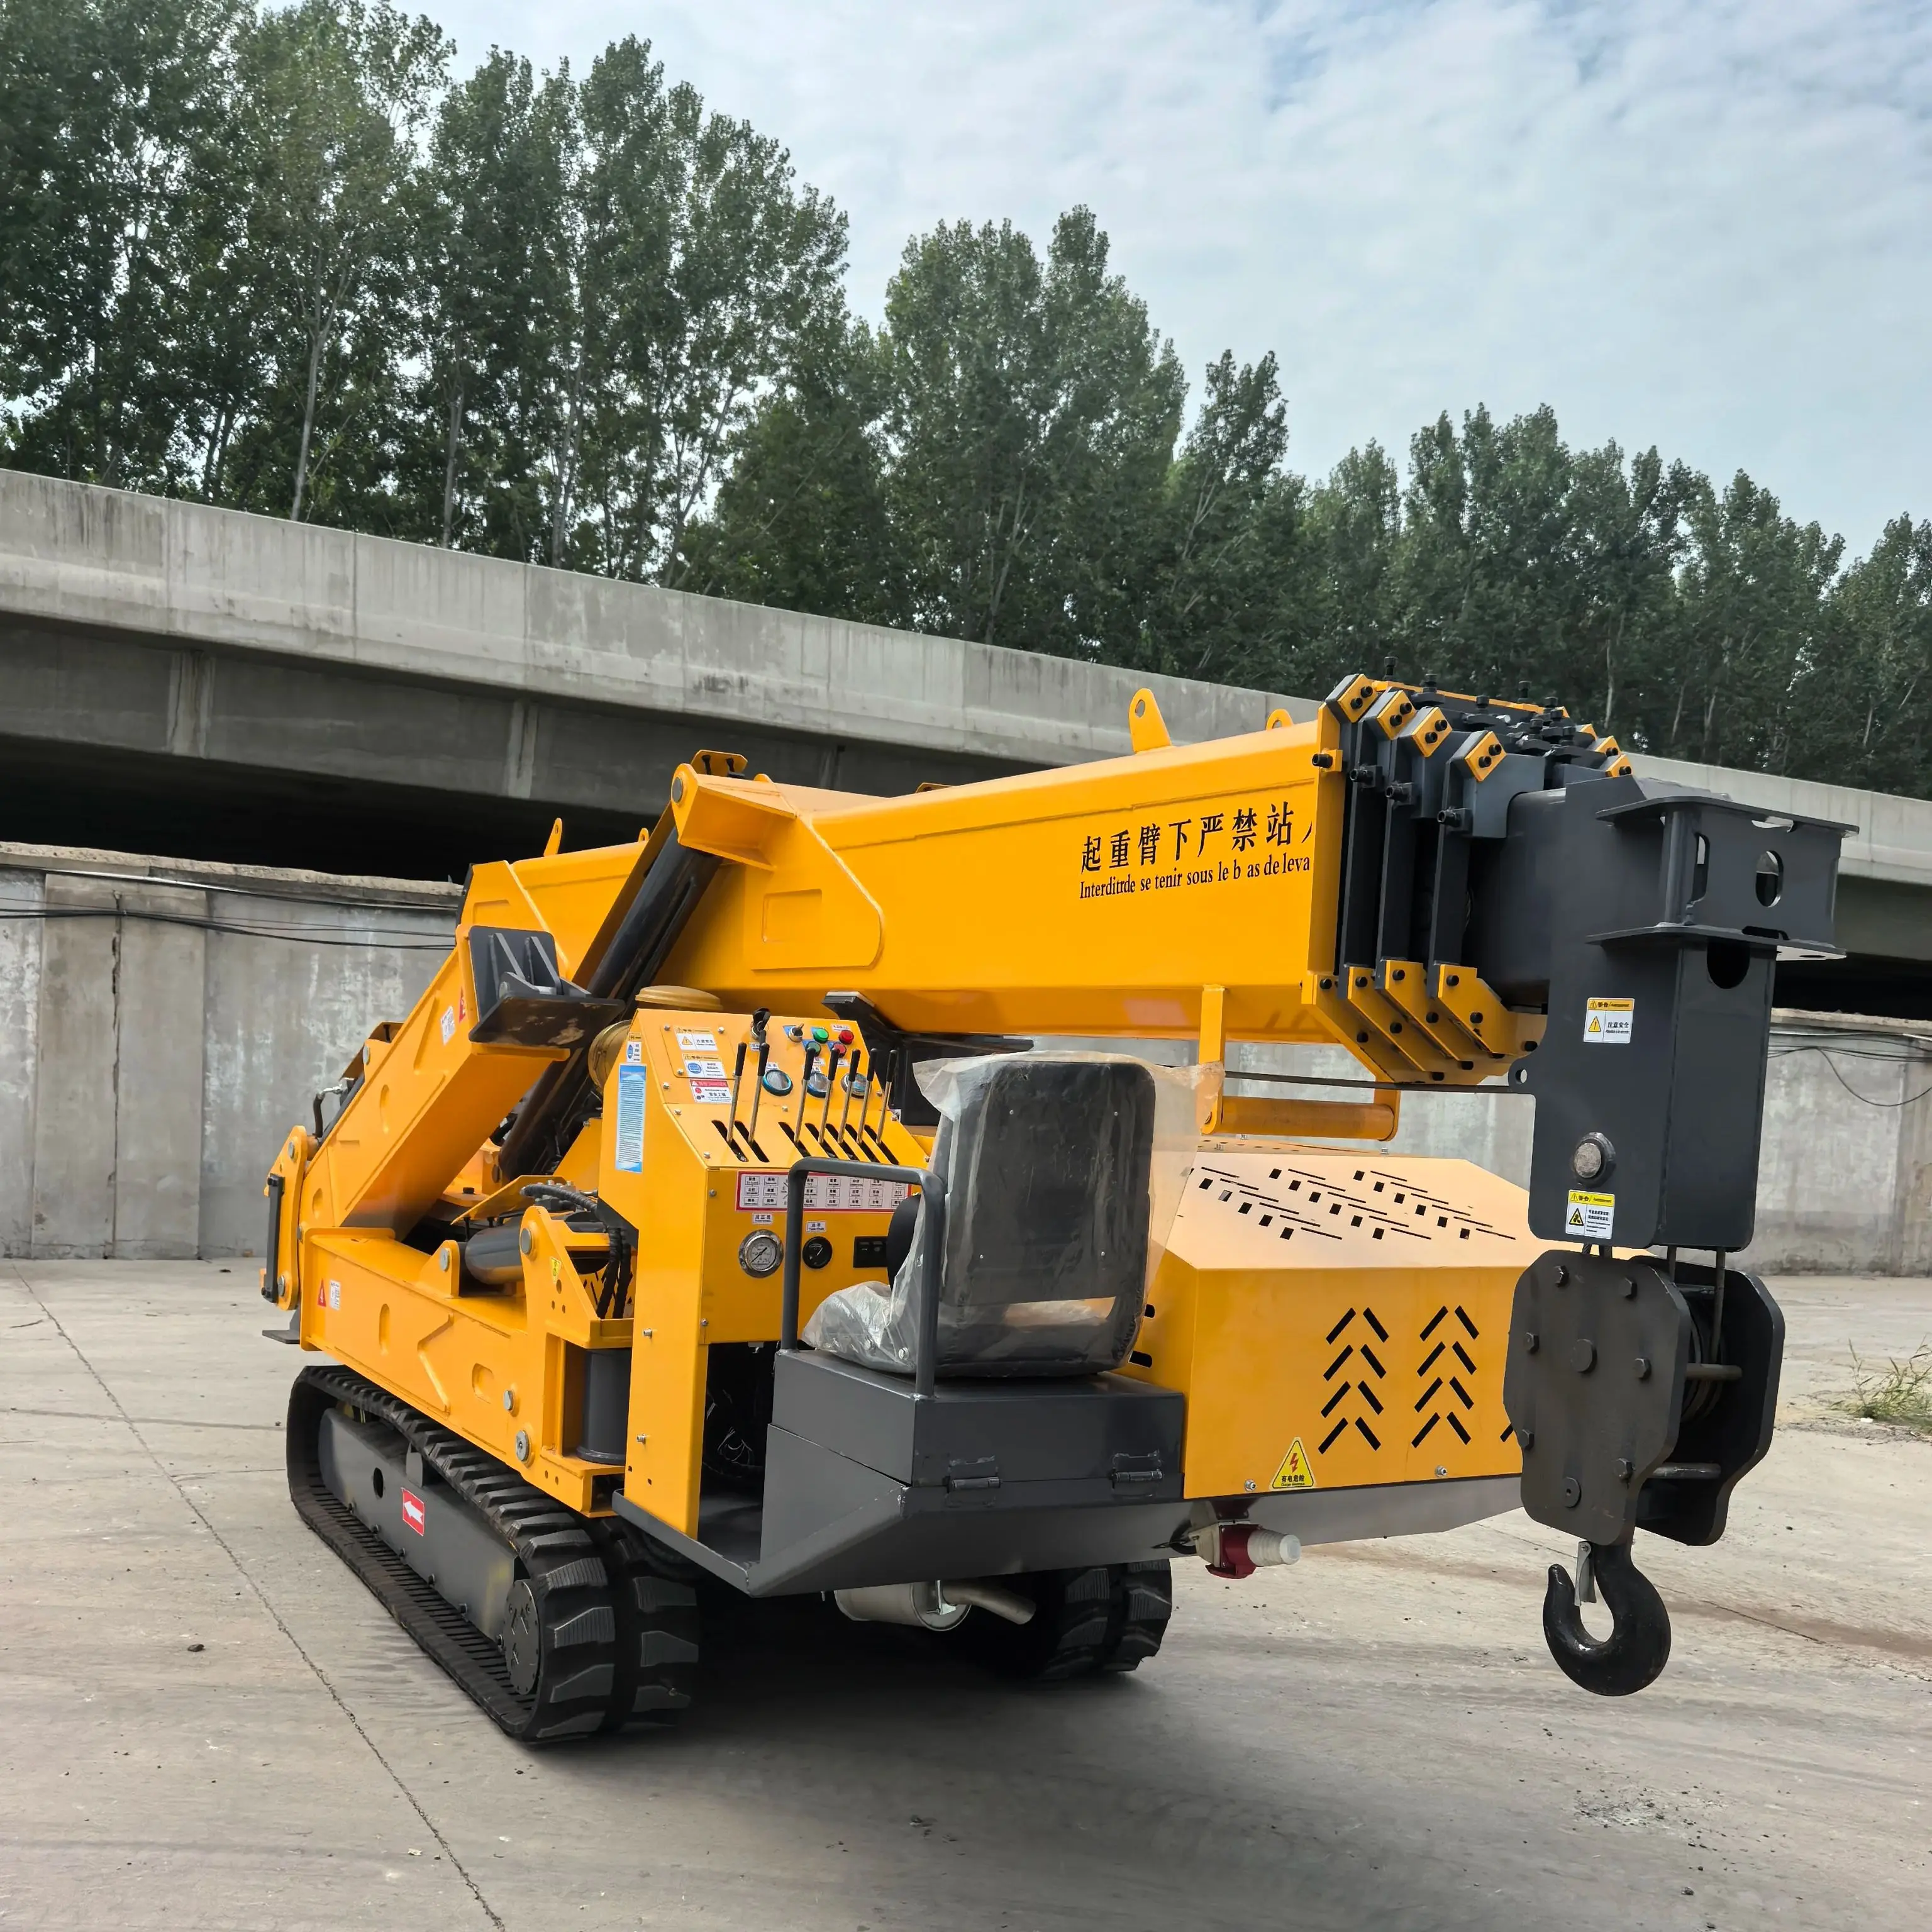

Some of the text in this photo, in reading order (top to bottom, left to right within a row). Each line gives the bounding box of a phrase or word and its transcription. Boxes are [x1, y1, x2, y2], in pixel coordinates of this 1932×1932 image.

[1140, 878, 1151, 891] se
[1155, 867, 1182, 889] tenir
[1187, 869, 1213, 885] sous
[1218, 861, 1229, 881] le
